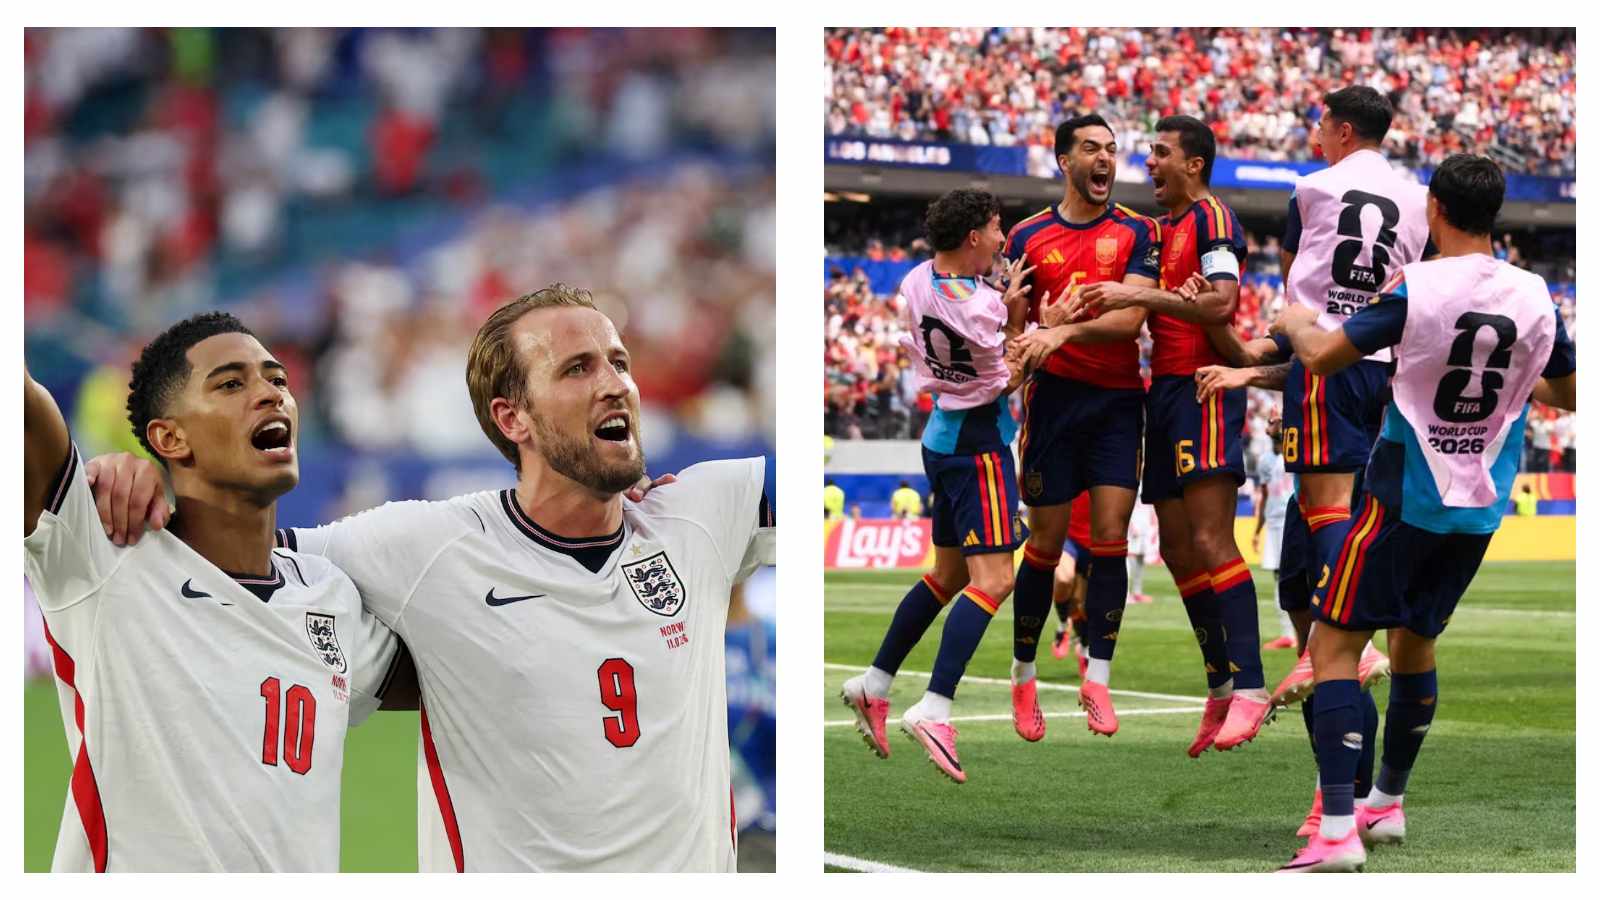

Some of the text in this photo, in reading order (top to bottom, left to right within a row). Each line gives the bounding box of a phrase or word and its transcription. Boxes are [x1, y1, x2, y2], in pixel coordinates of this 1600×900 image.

[1349, 269, 1376, 284] FIFA
[1328, 290, 1364, 304] WORLD
[1453, 401, 1480, 414] FIFA
[1428, 424, 1488, 437] WORLD CUP
[1428, 438, 1485, 454] 2026
[836, 518, 923, 569] Lay's
[660, 621, 686, 637] NORW
[597, 657, 641, 748] 9
[260, 676, 317, 776] 10
